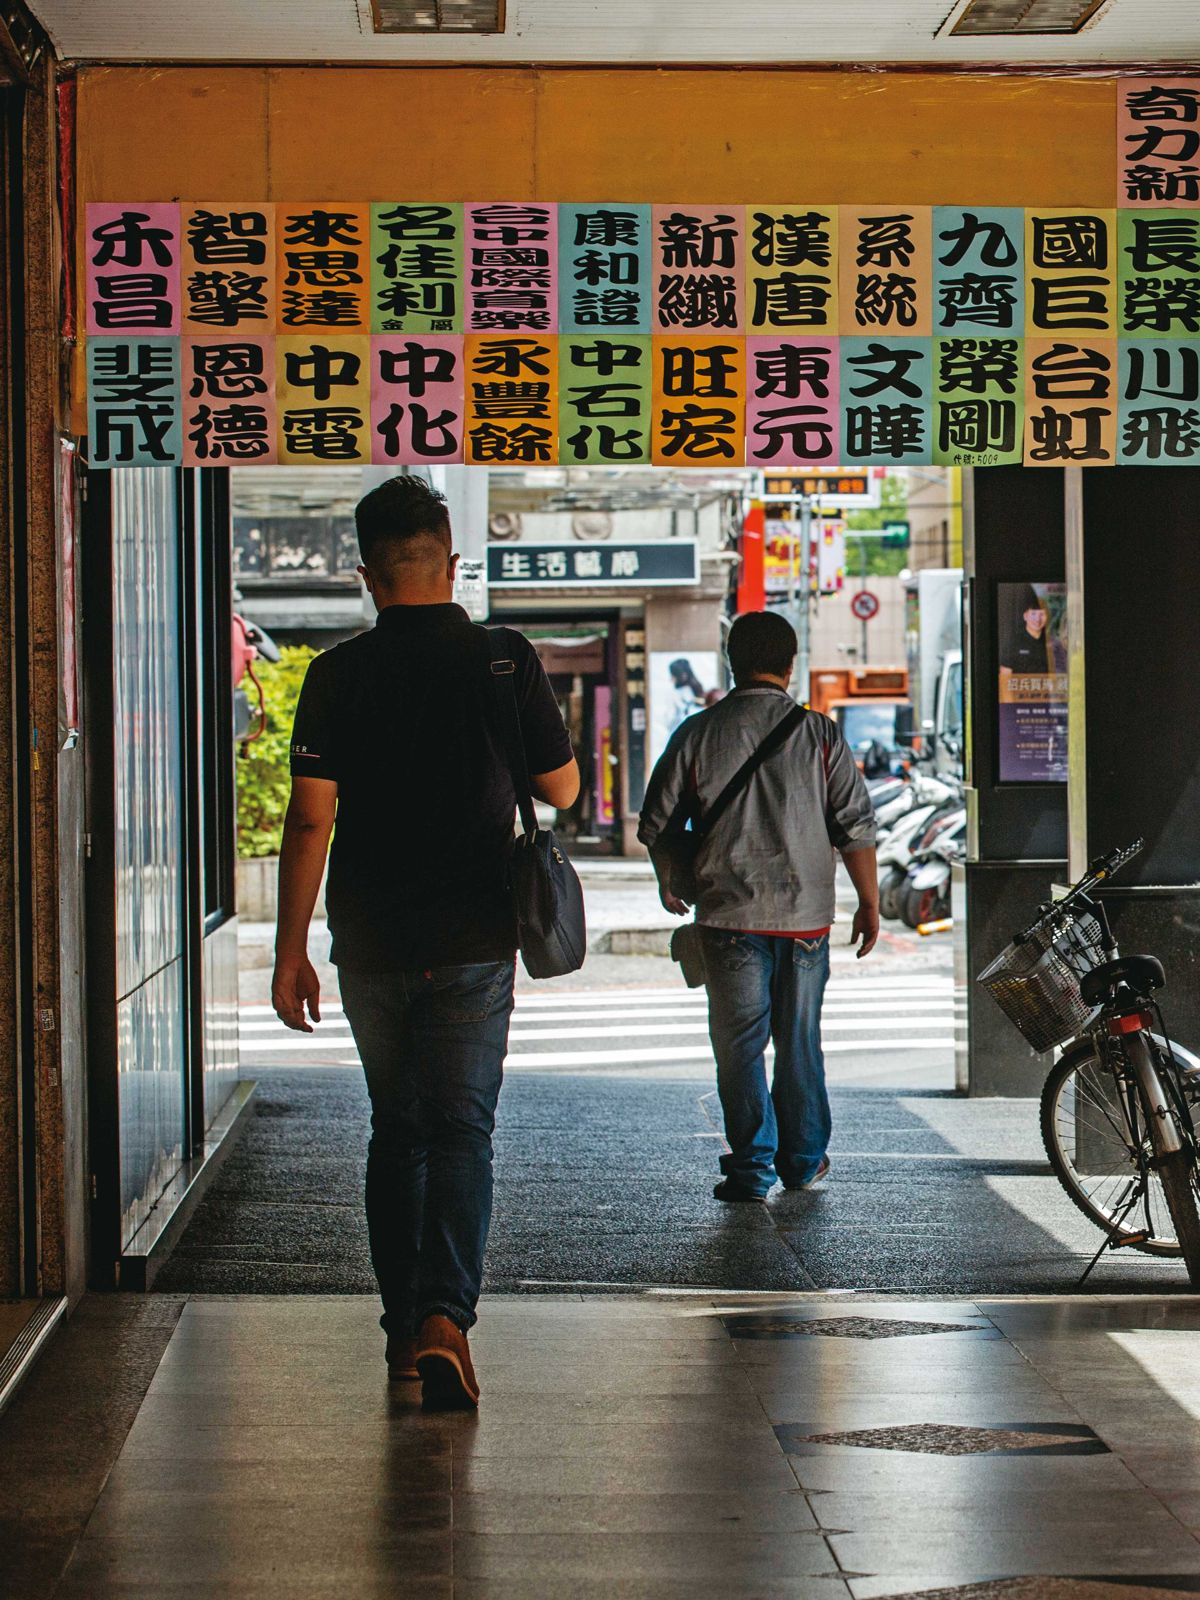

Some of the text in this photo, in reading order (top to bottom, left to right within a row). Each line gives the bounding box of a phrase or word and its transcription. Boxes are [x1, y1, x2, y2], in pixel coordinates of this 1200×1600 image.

[1124, 86, 1200, 201] 奇力新
[187, 210, 268, 326] 智擎
[282, 210, 363, 326] 來思達
[377, 206, 457, 317] 名佳利
[471, 206, 551, 329] 台中國際育樂
[573, 210, 640, 325] 康和證
[659, 213, 738, 328] 新纖
[752, 212, 831, 326] 漢唐
[855, 215, 917, 326] 系統
[939, 213, 1017, 328] 九齊
[1032, 216, 1110, 329] 國巨
[94, 345, 175, 461] 斐成
[188, 343, 269, 459] 恩德
[283, 345, 363, 459] 中電
[377, 342, 457, 457] 中化
[469, 339, 552, 461] 永豐餘
[567, 341, 643, 459] 中石化
[661, 346, 738, 458] 旺宏
[753, 344, 832, 459] 東元
[846, 344, 924, 458] 文曄
[939, 339, 1018, 452] 榮剛
[1030, 344, 1111, 460] 台虹
[1122, 347, 1200, 458] 川飛
